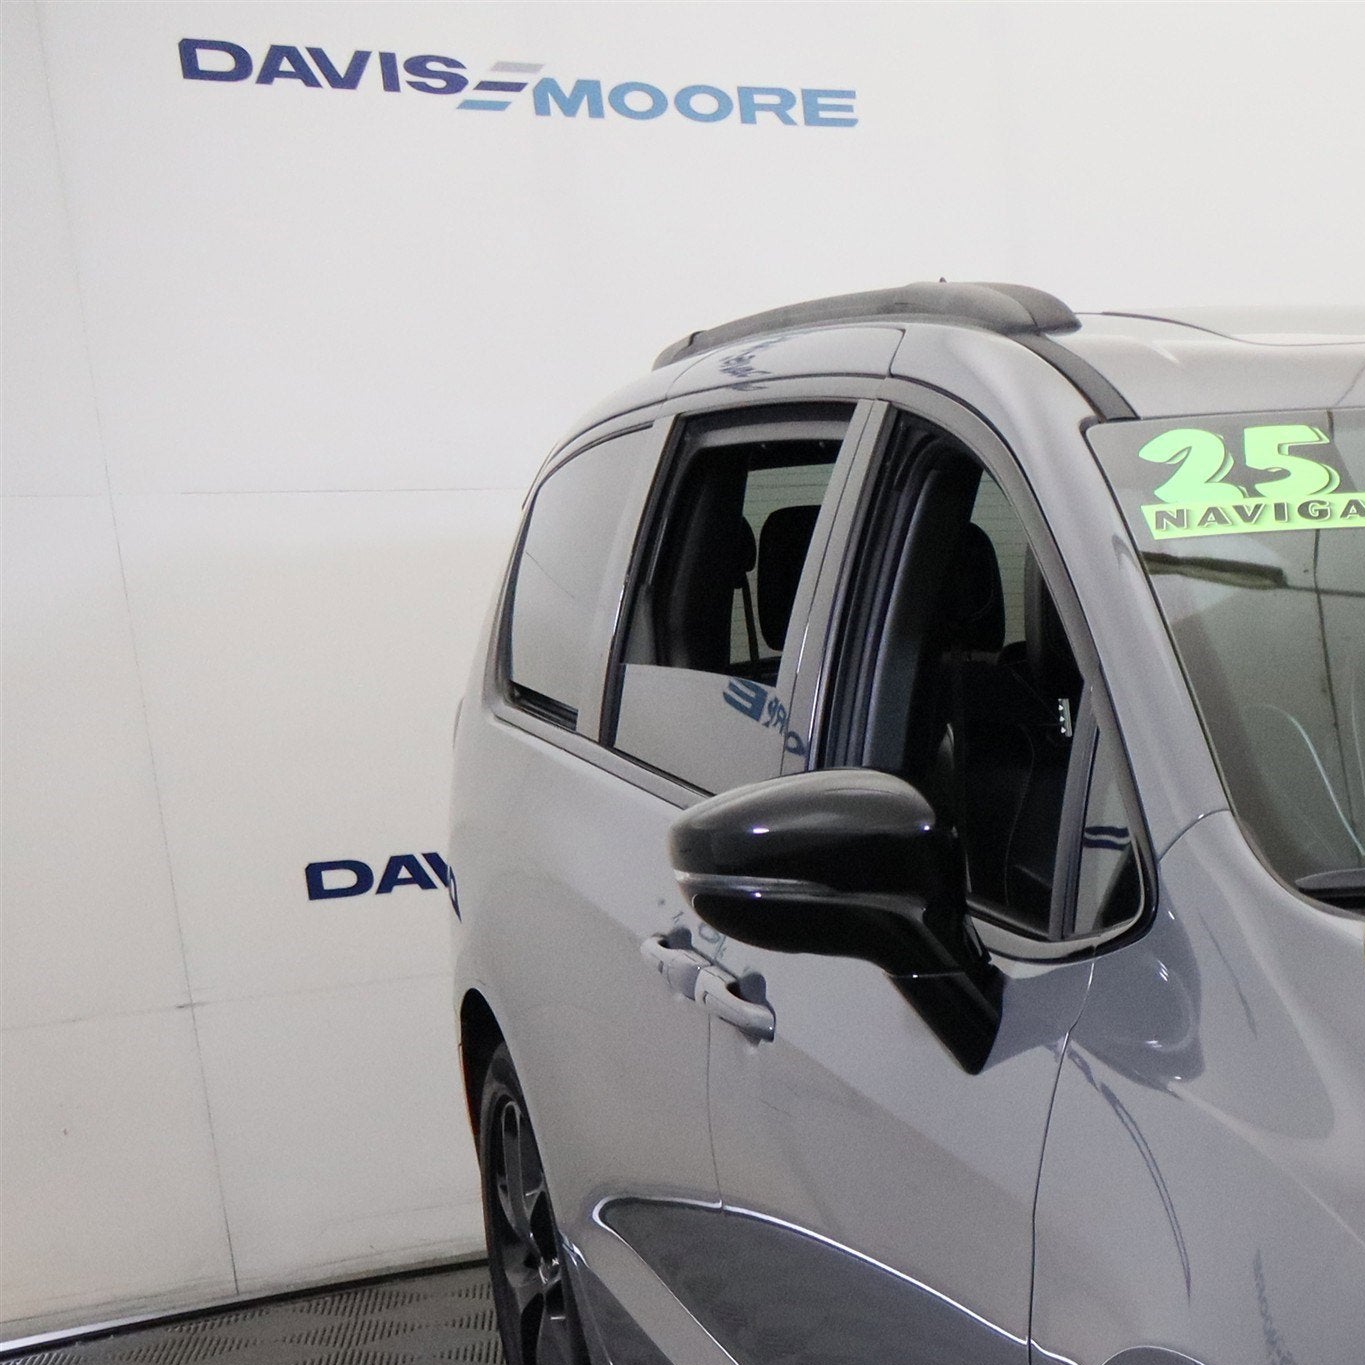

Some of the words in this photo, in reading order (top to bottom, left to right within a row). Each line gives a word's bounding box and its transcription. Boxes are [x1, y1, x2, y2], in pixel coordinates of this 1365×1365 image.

[177, 37, 469, 97] DAVIS
[532, 76, 860, 128] MOORE
[1138, 424, 1341, 502] 25
